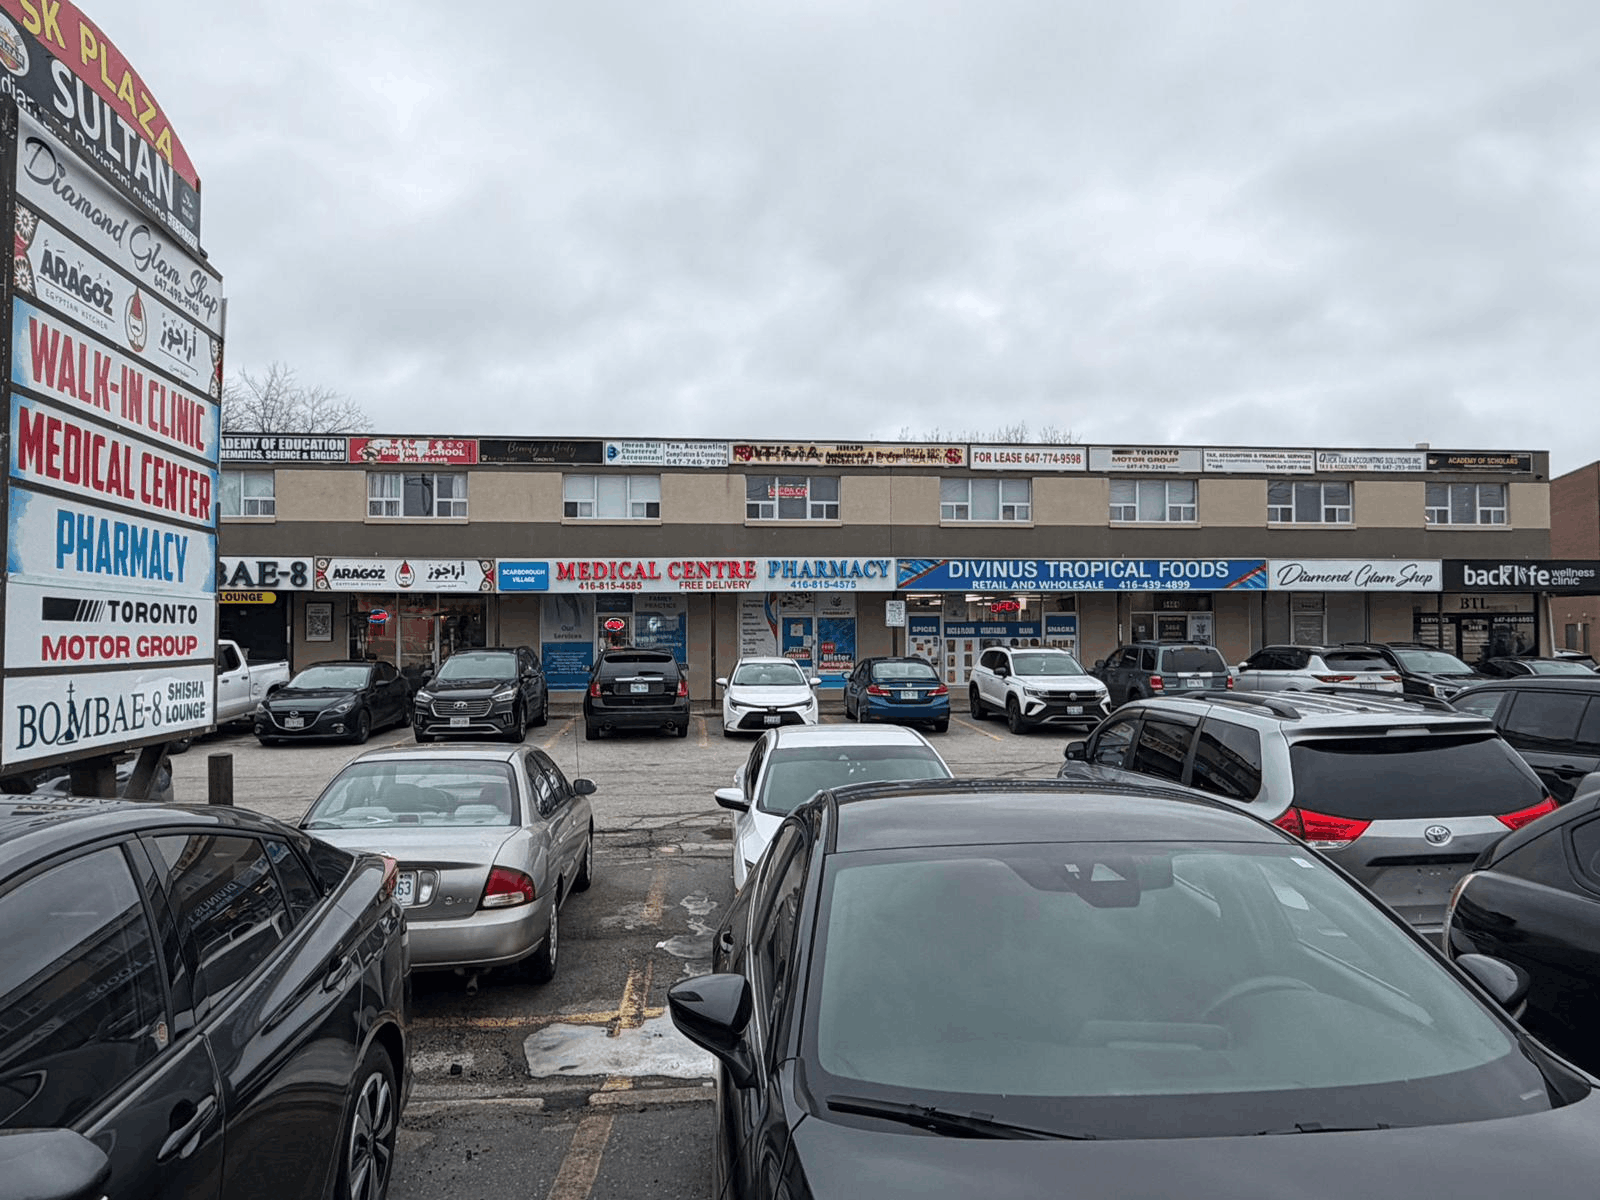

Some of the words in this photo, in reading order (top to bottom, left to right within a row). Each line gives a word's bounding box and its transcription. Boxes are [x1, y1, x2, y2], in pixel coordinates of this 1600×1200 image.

[79, 21, 173, 166] PLAZA
[51, 59, 173, 210] SULTAN
[24, 136, 128, 248] Diamond
[129, 224, 180, 285] Glam
[184, 270, 218, 322] Shop
[40, 249, 113, 316] ARAGOZ
[46, 288, 78, 312] EGYPTIAN
[29, 316, 143, 425] WALK-IN
[148, 379, 205, 451] CLINIC
[261, 439, 276, 450] OF
[278, 438, 345, 451] EDUCATION
[265, 450, 300, 459] SCIENCE
[302, 451, 308, 459] &
[310, 451, 345, 460] ENGLISH
[684, 443, 727, 451] Accounting
[18, 406, 135, 500] MEDICAL
[141, 451, 211, 520] CENTER
[974, 452, 992, 462] FOR
[995, 452, 1022, 463] LEASE
[1025, 453, 1081, 464] 647-774-9598
[1487, 457, 1518, 465] SCHOLARS
[56, 509, 188, 583] PHARMACY
[333, 568, 385, 580] ARAGOZ
[556, 561, 661, 581] MEDICAL
[667, 560, 757, 580] CENTRE
[768, 560, 891, 579] PHARMACY
[949, 561, 1038, 578] DIVINUS
[1045, 561, 1151, 578] TROPICAL
[1159, 561, 1229, 578] FOODS
[1277, 563, 1352, 586] Diamond
[1355, 564, 1396, 587] Glam
[1396, 563, 1433, 587] Shop
[1551, 568, 1595, 577] wellness
[579, 581, 642, 590] 416-815-4585
[679, 581, 703, 589] FREE
[706, 580, 751, 589] DELIVERY
[790, 580, 856, 589] 416-815-4575
[972, 580, 1008, 589] RETAIL
[1011, 580, 1036, 589] AND
[1039, 580, 1104, 589] WHOLESALE
[1119, 580, 1190, 589] 416-439-4899
[1551, 577, 1580, 585] clinic
[107, 600, 198, 624] TORONTO
[991, 600, 1020, 613] OPEN
[1460, 597, 1489, 610] BTL
[41, 635, 131, 661] MOTOR
[136, 635, 198, 657] GROUP
[167, 680, 205, 701] SHISHA
[16, 689, 162, 750] BOMBAE-8
[165, 701, 206, 724] LOUNGE
